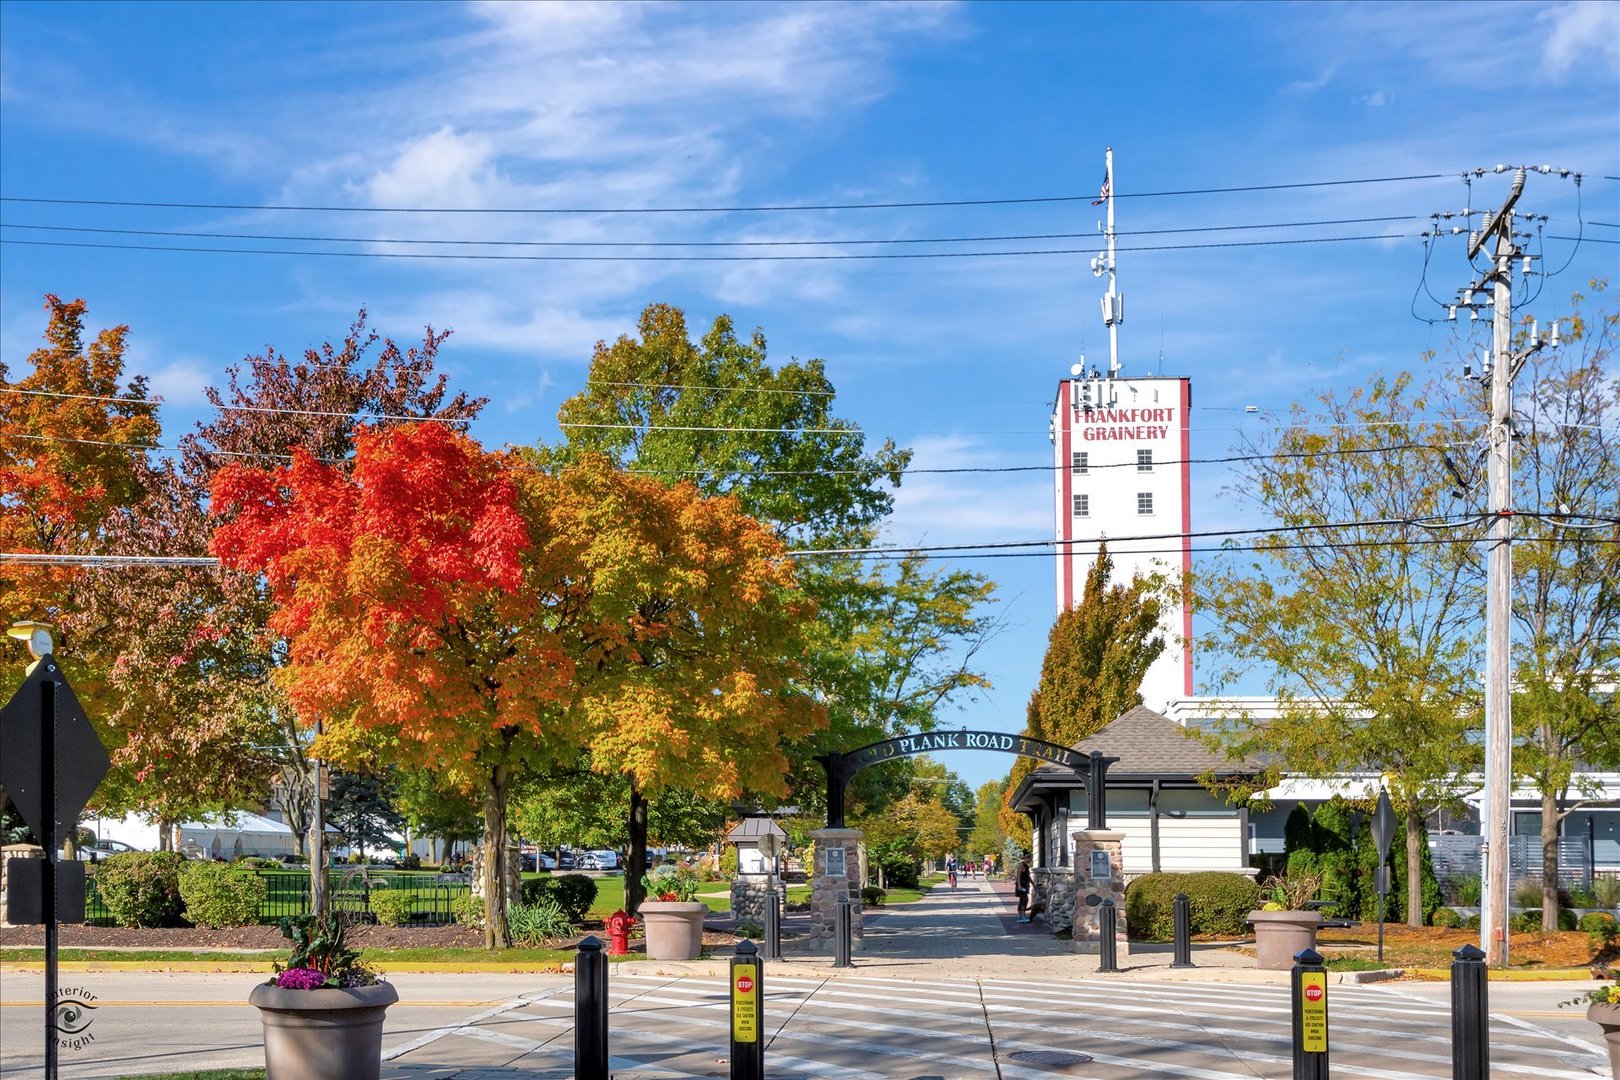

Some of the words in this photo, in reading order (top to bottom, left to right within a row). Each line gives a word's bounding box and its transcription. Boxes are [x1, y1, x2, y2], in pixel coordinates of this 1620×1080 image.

[1074, 408, 1175, 424] FRANKFORT
[1083, 425, 1168, 441] GRAINERY
[899, 733, 960, 753] PLANK
[966, 733, 1013, 750] ROAD
[1306, 989, 1322, 997] STOP
